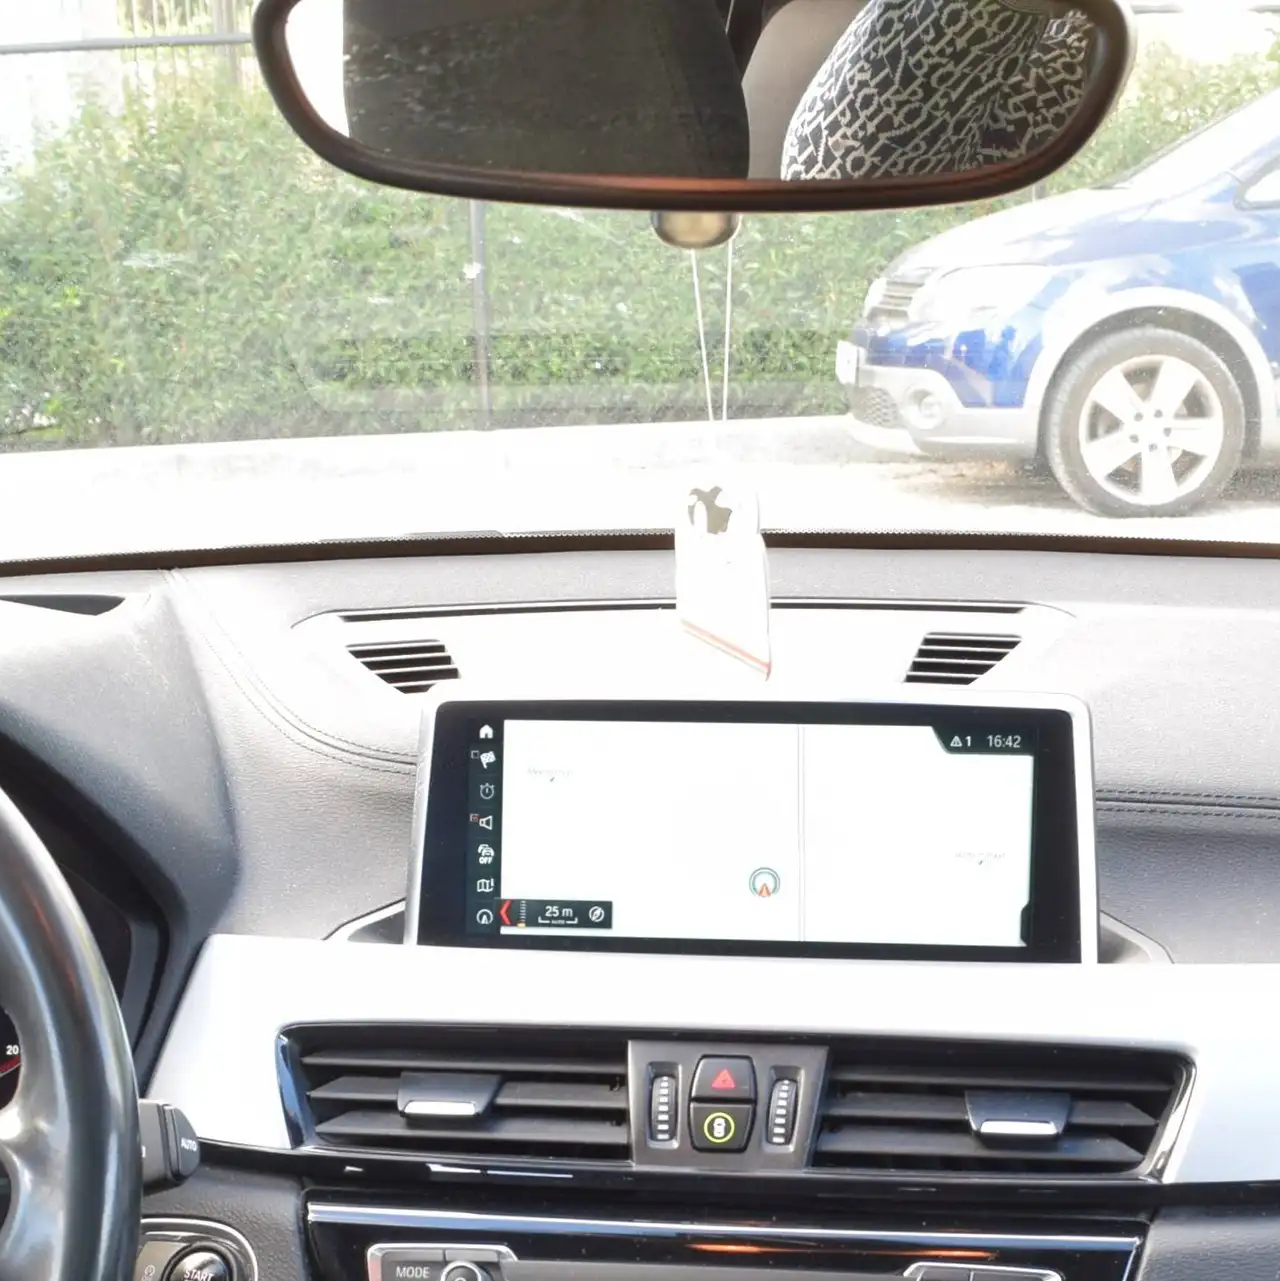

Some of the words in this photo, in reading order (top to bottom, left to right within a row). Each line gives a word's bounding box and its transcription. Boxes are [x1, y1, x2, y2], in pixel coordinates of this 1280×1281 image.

[965, 735, 972, 747] 1
[987, 734, 1022, 748] 16:42
[545, 905, 560, 917] 25
[561, 908, 573, 917] m
[6, 1045, 19, 1055] 20
[396, 1266, 430, 1279] MODE
